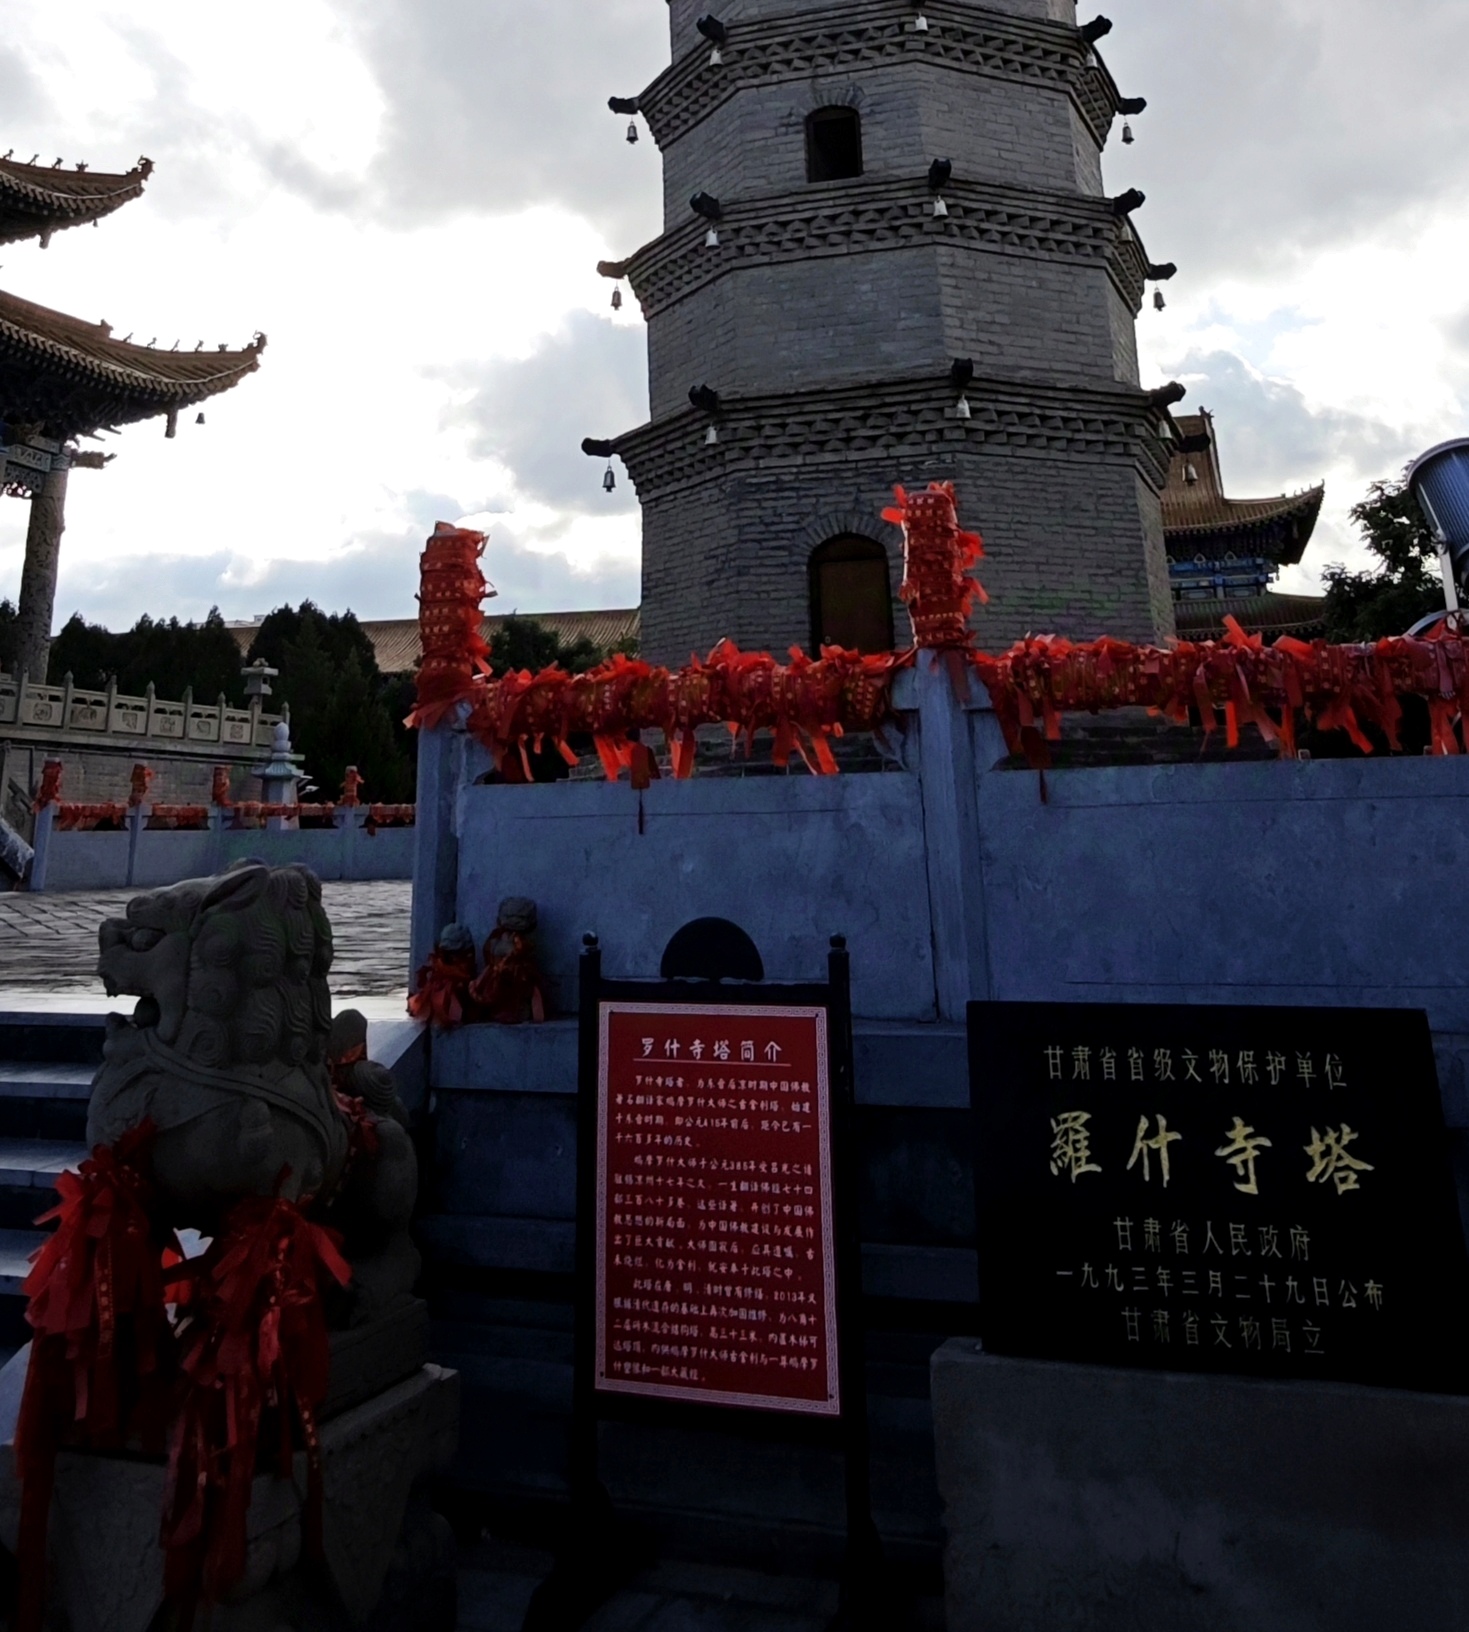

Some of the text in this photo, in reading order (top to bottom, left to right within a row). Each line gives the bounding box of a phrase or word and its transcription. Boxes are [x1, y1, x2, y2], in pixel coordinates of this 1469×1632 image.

[641, 1037, 782, 1062] 罗什寺塔简介
[1043, 1045, 1348, 1090] 甘肃省省级文物保护单位
[1049, 1110, 1376, 1195] 羅什寺塔
[1112, 1216, 1311, 1261] 甘肃省人民政府
[1055, 1262, 1384, 1310] 一九九三年三月二十九日公布
[1120, 1306, 1325, 1353] 甘肃省文物局立
